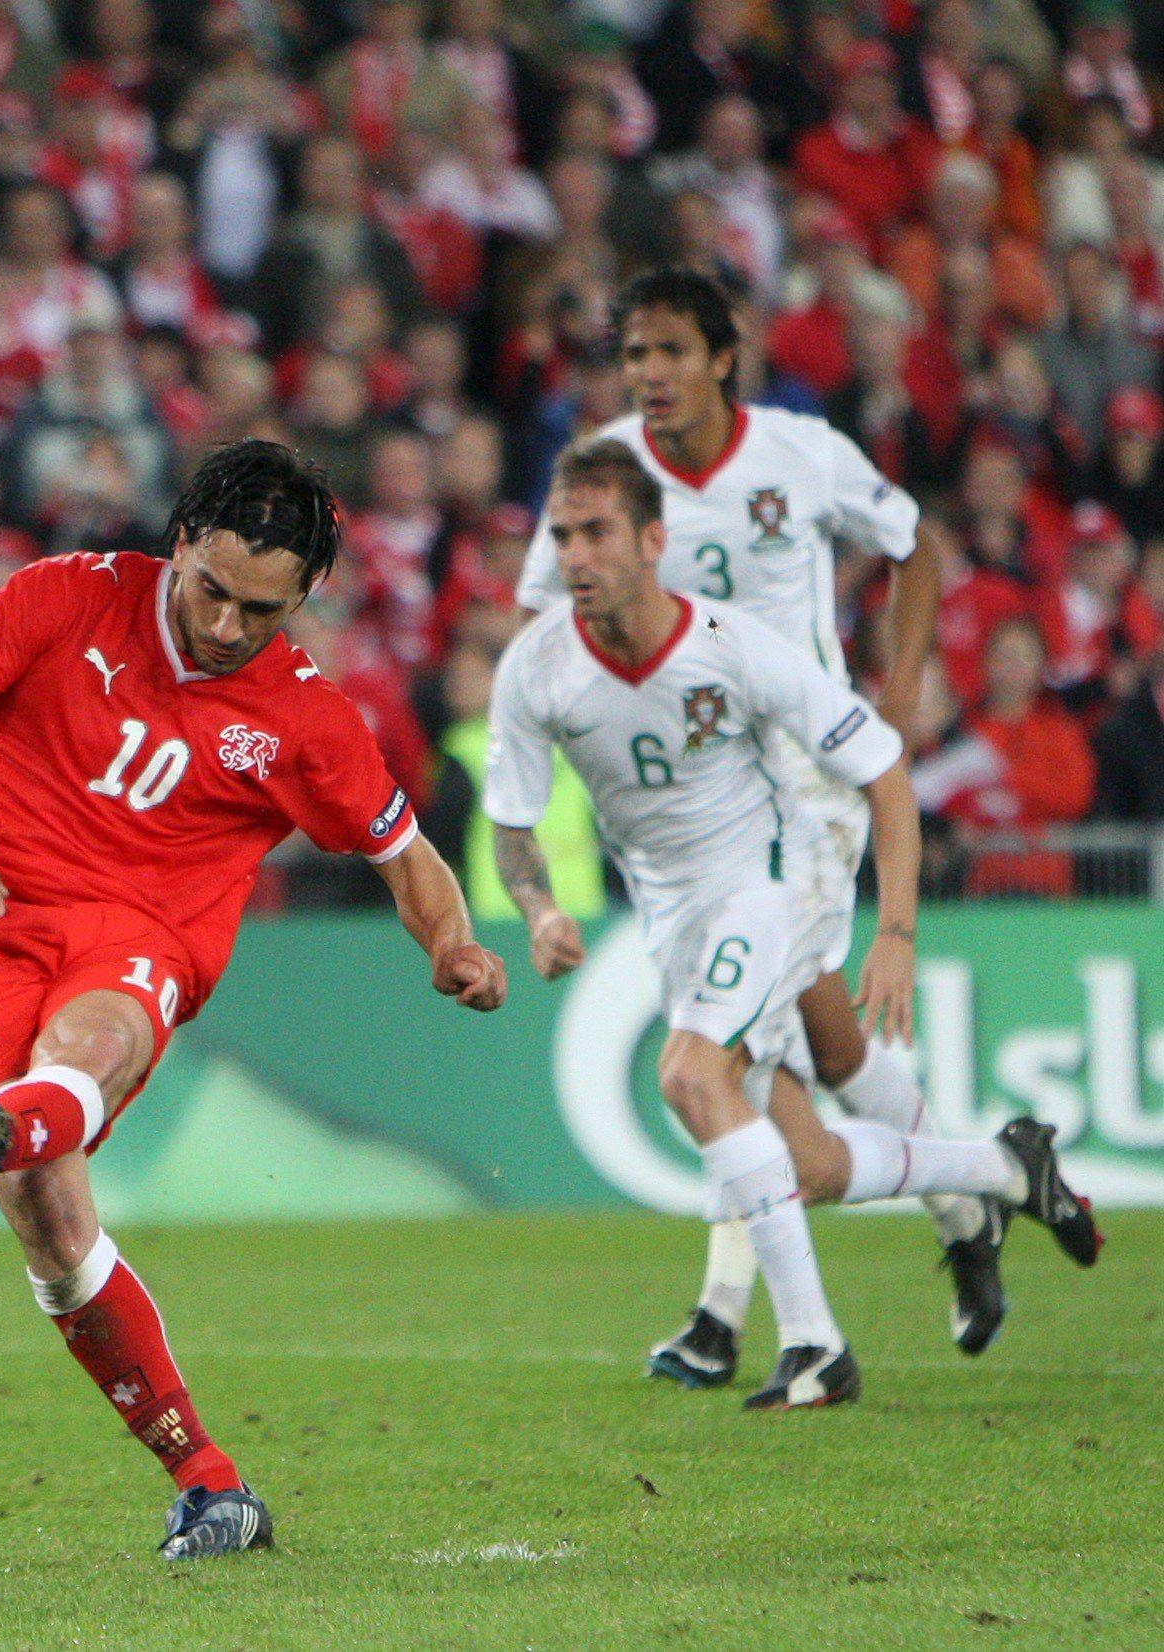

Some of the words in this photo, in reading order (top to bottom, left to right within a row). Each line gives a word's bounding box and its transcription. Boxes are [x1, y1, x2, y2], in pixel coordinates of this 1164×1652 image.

[694, 542, 733, 600] 3
[86, 717, 192, 811] 10
[629, 731, 673, 789] 6
[705, 935, 751, 990] 6
[120, 956, 179, 1029] 10
